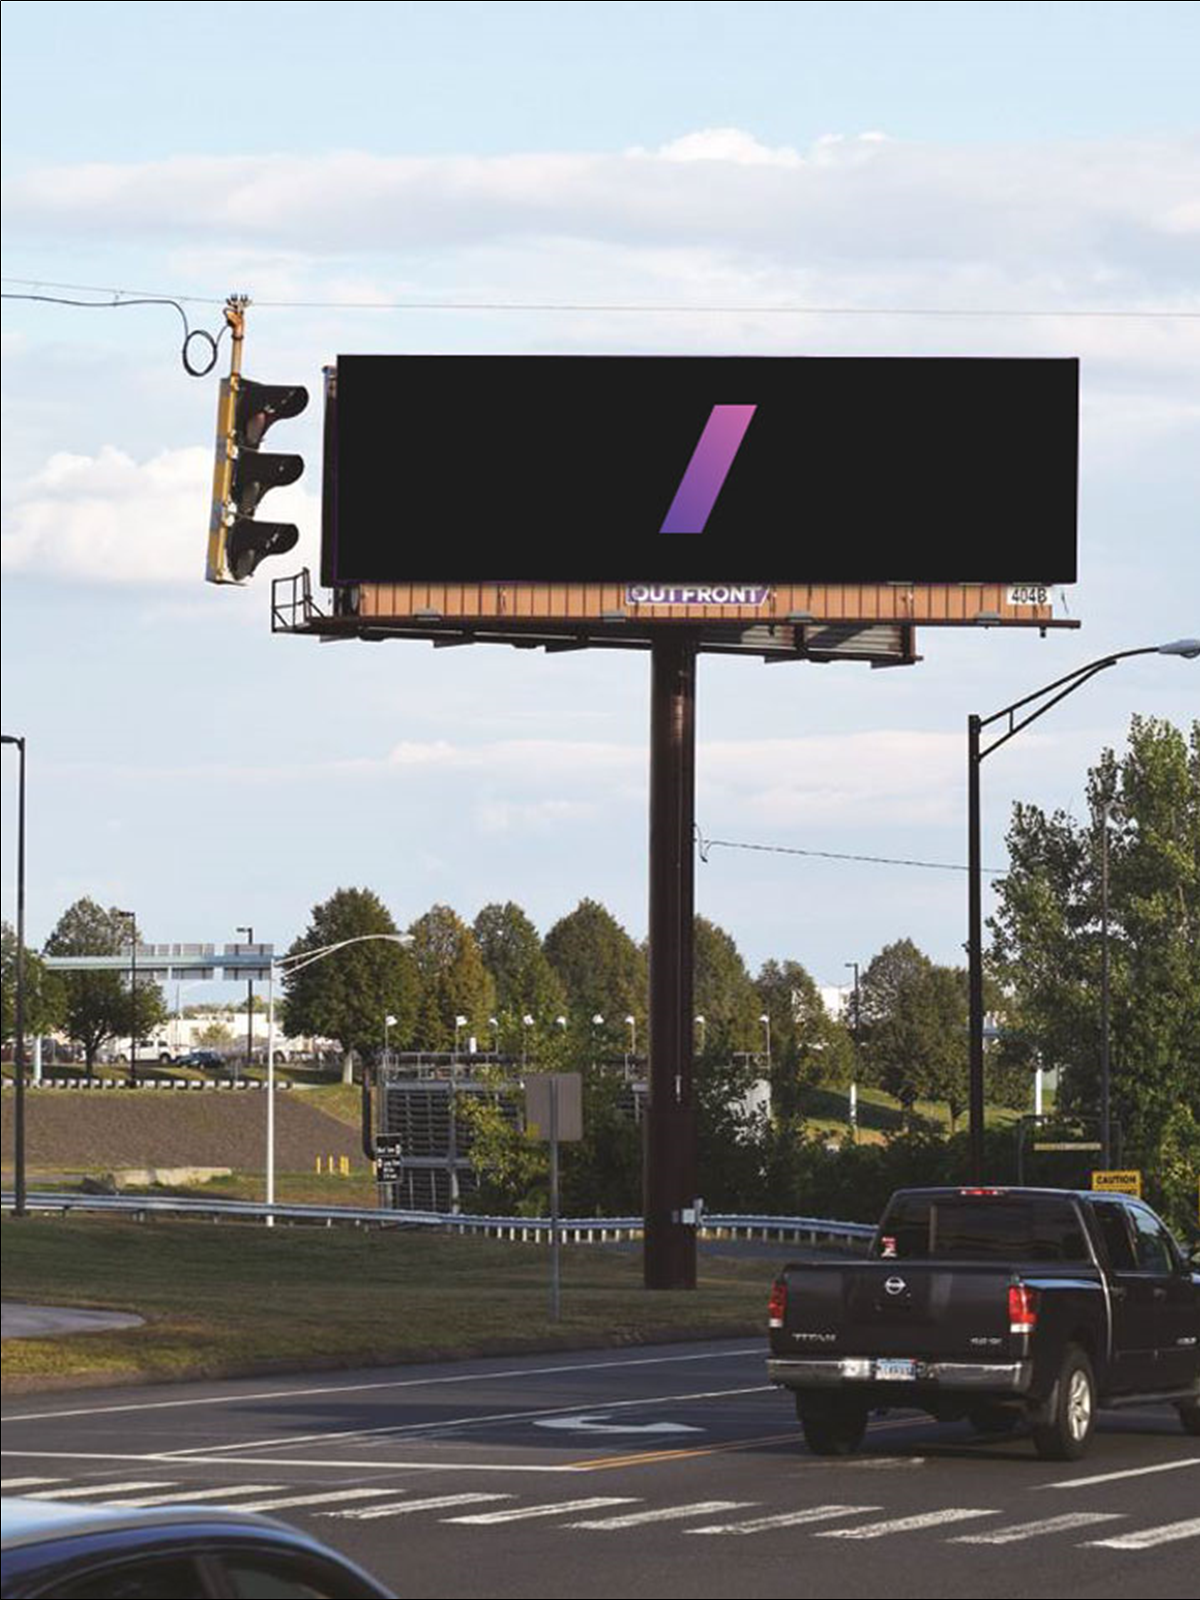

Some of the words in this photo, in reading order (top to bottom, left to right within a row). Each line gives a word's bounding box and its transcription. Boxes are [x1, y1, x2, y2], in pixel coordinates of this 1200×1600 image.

[631, 586, 762, 603] OUTFRONT
[1011, 587, 1047, 603] 404B
[1096, 1175, 1136, 1184] CAUTION
